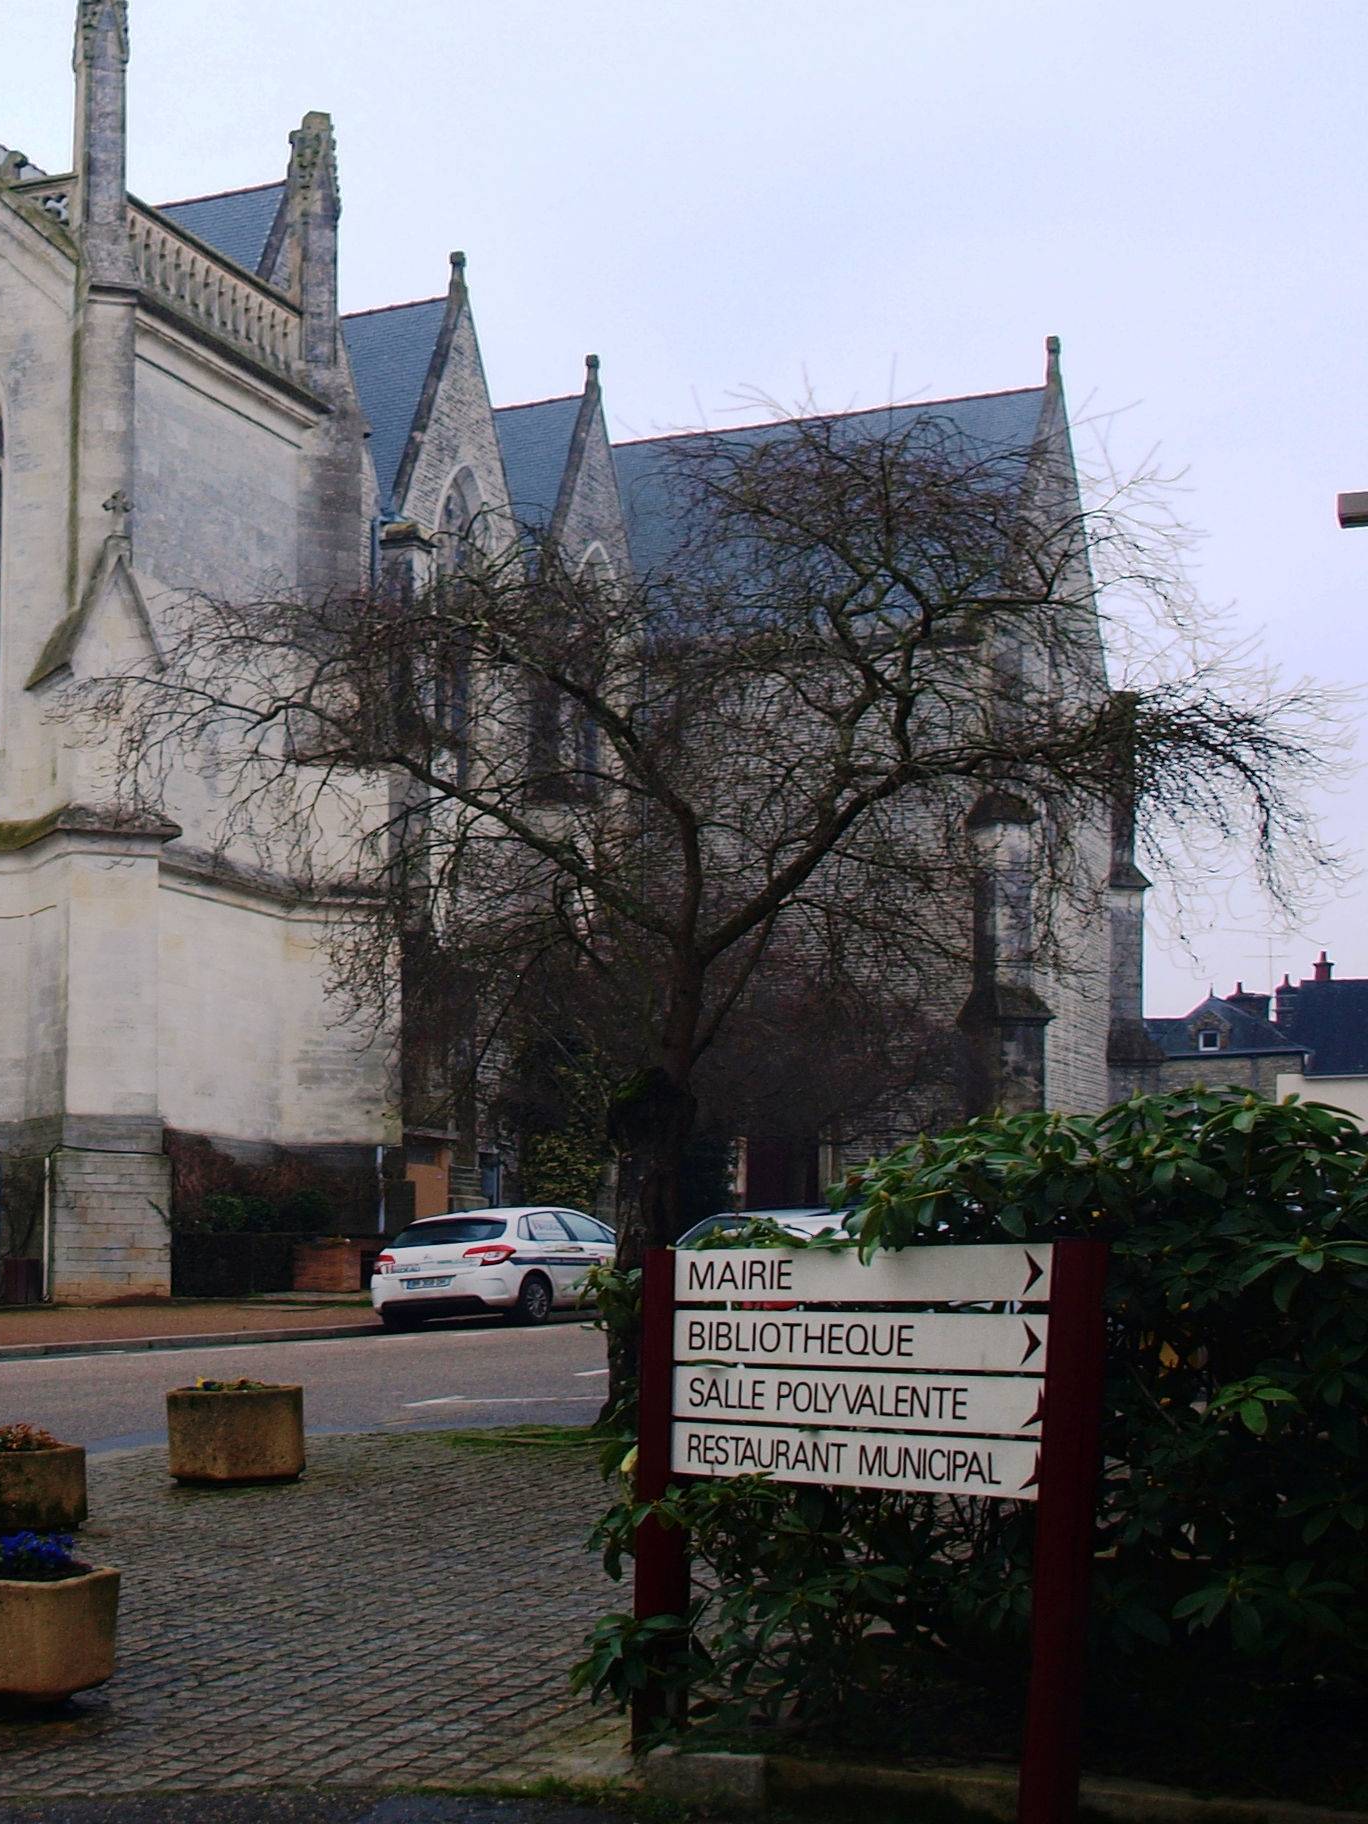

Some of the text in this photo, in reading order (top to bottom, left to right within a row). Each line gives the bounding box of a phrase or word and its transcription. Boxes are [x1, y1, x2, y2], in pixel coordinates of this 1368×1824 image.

[689, 1260, 793, 1290] MAIRIE
[688, 1321, 914, 1356] BIBLIOTHEQUE
[689, 1377, 968, 1420] SALLE POLYVALENTE
[687, 1434, 1002, 1485] RESTAURANT MUNICIPAL
